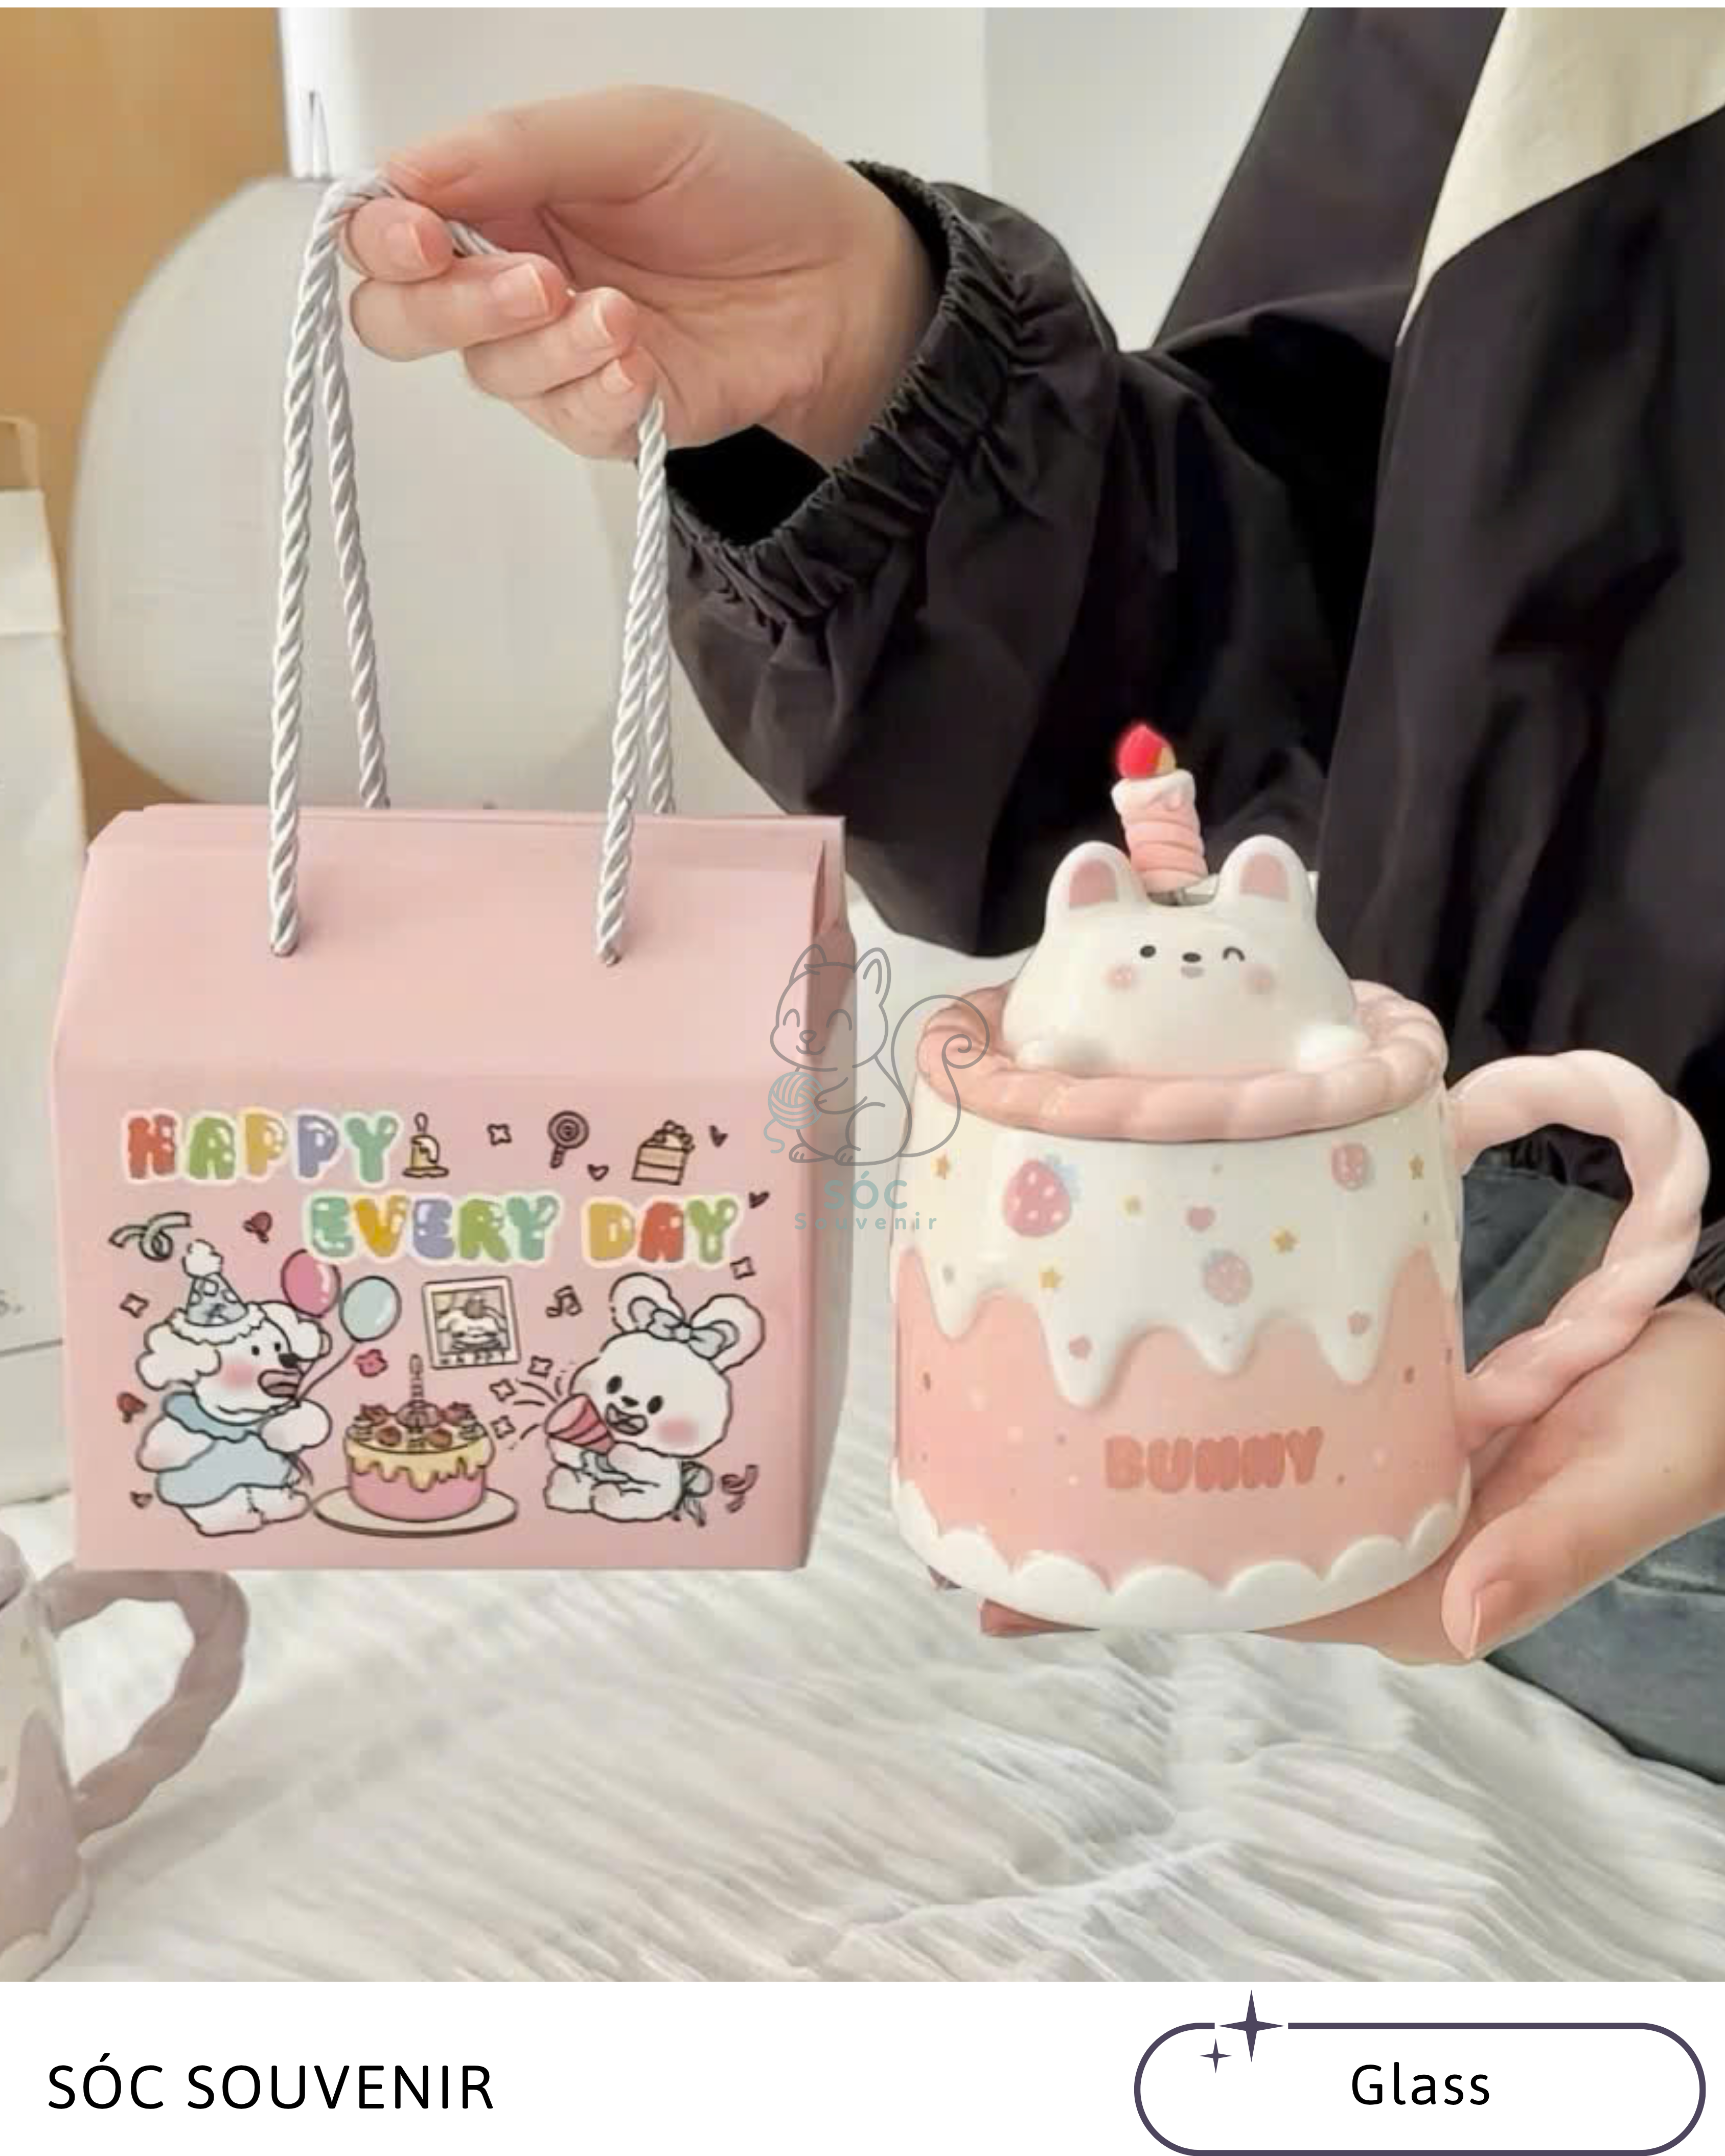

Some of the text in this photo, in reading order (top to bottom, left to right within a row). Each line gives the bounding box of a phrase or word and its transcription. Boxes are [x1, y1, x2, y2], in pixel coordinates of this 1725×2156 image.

[126, 1111, 400, 1183] HAPPY
[309, 1194, 739, 1264] EVERY DAY
[1105, 1426, 1325, 1493] BUNNY
